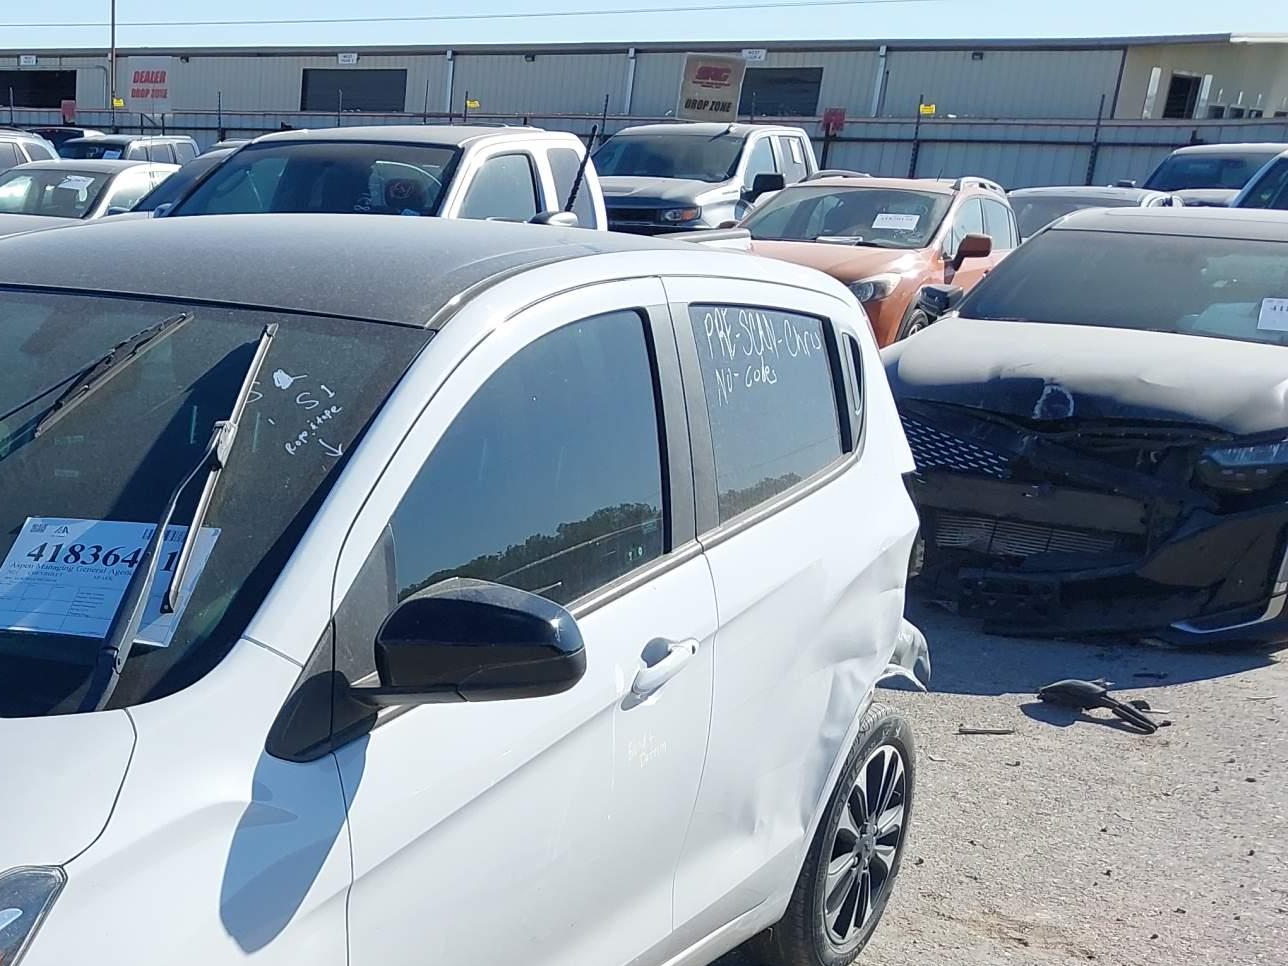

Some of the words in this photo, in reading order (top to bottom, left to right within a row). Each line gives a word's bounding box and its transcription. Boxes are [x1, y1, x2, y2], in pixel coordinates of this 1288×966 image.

[132, 70, 167, 84] DEALER
[684, 98, 709, 111] DROP
[709, 100, 733, 113] ZONE
[9, 559, 34, 569] Aspen
[35, 563, 74, 574] Managing
[75, 565, 108, 575] General
